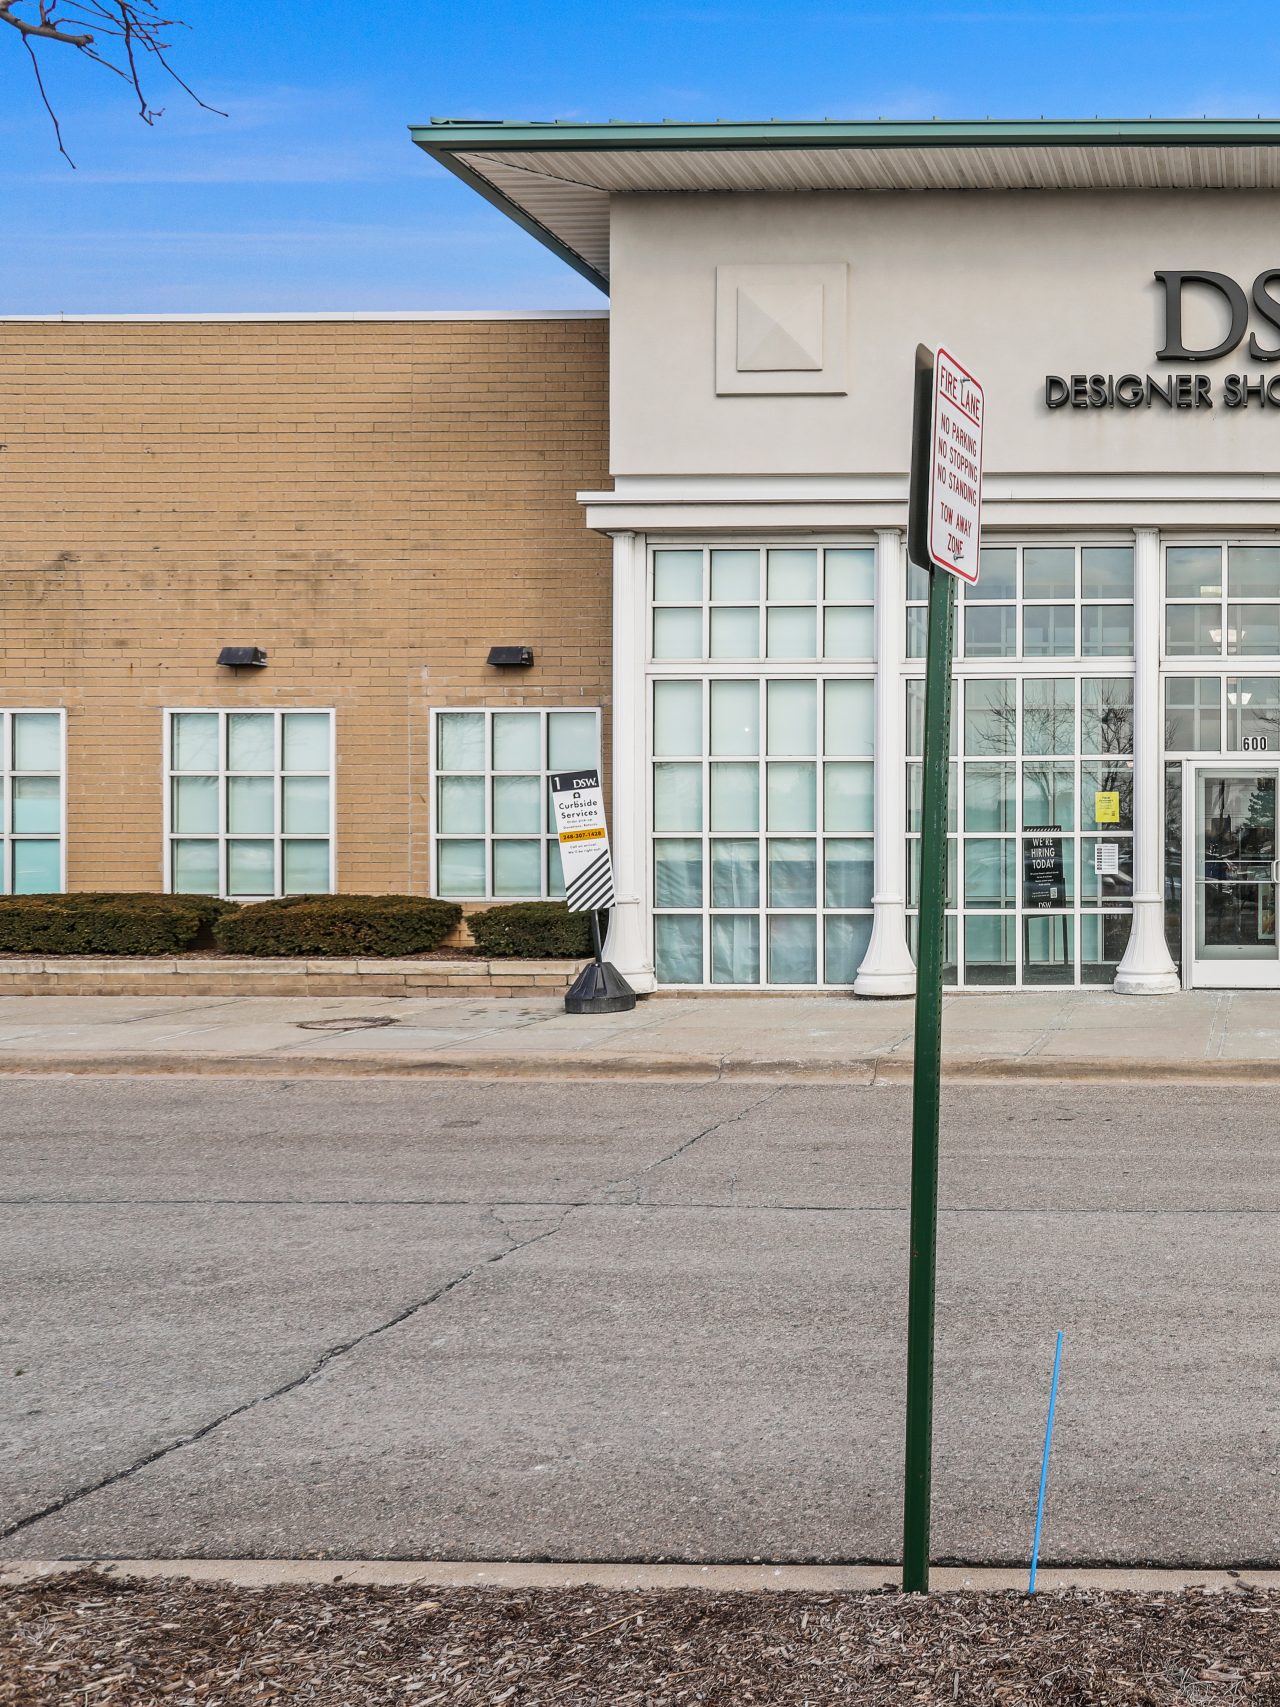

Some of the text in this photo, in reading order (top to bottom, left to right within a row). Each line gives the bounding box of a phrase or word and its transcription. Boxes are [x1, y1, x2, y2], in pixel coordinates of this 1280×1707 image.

[941, 365, 981, 421] FIRE LANE
[1045, 374, 1213, 408] DESIGNER
[940, 412, 977, 457] NO PARKING
[938, 436, 978, 483] NO STOPPING
[937, 462, 977, 507] NO STANDING
[940, 501, 972, 538] TOW AWAY
[947, 532, 964, 555] ZONE
[1243, 737, 1267, 751] 600
[554, 777, 561, 790] 1
[559, 800, 598, 810] Curbside
[561, 810, 598, 819] Services
[1031, 847, 1056, 858] HIRING
[1032, 859, 1055, 869] TODAY
